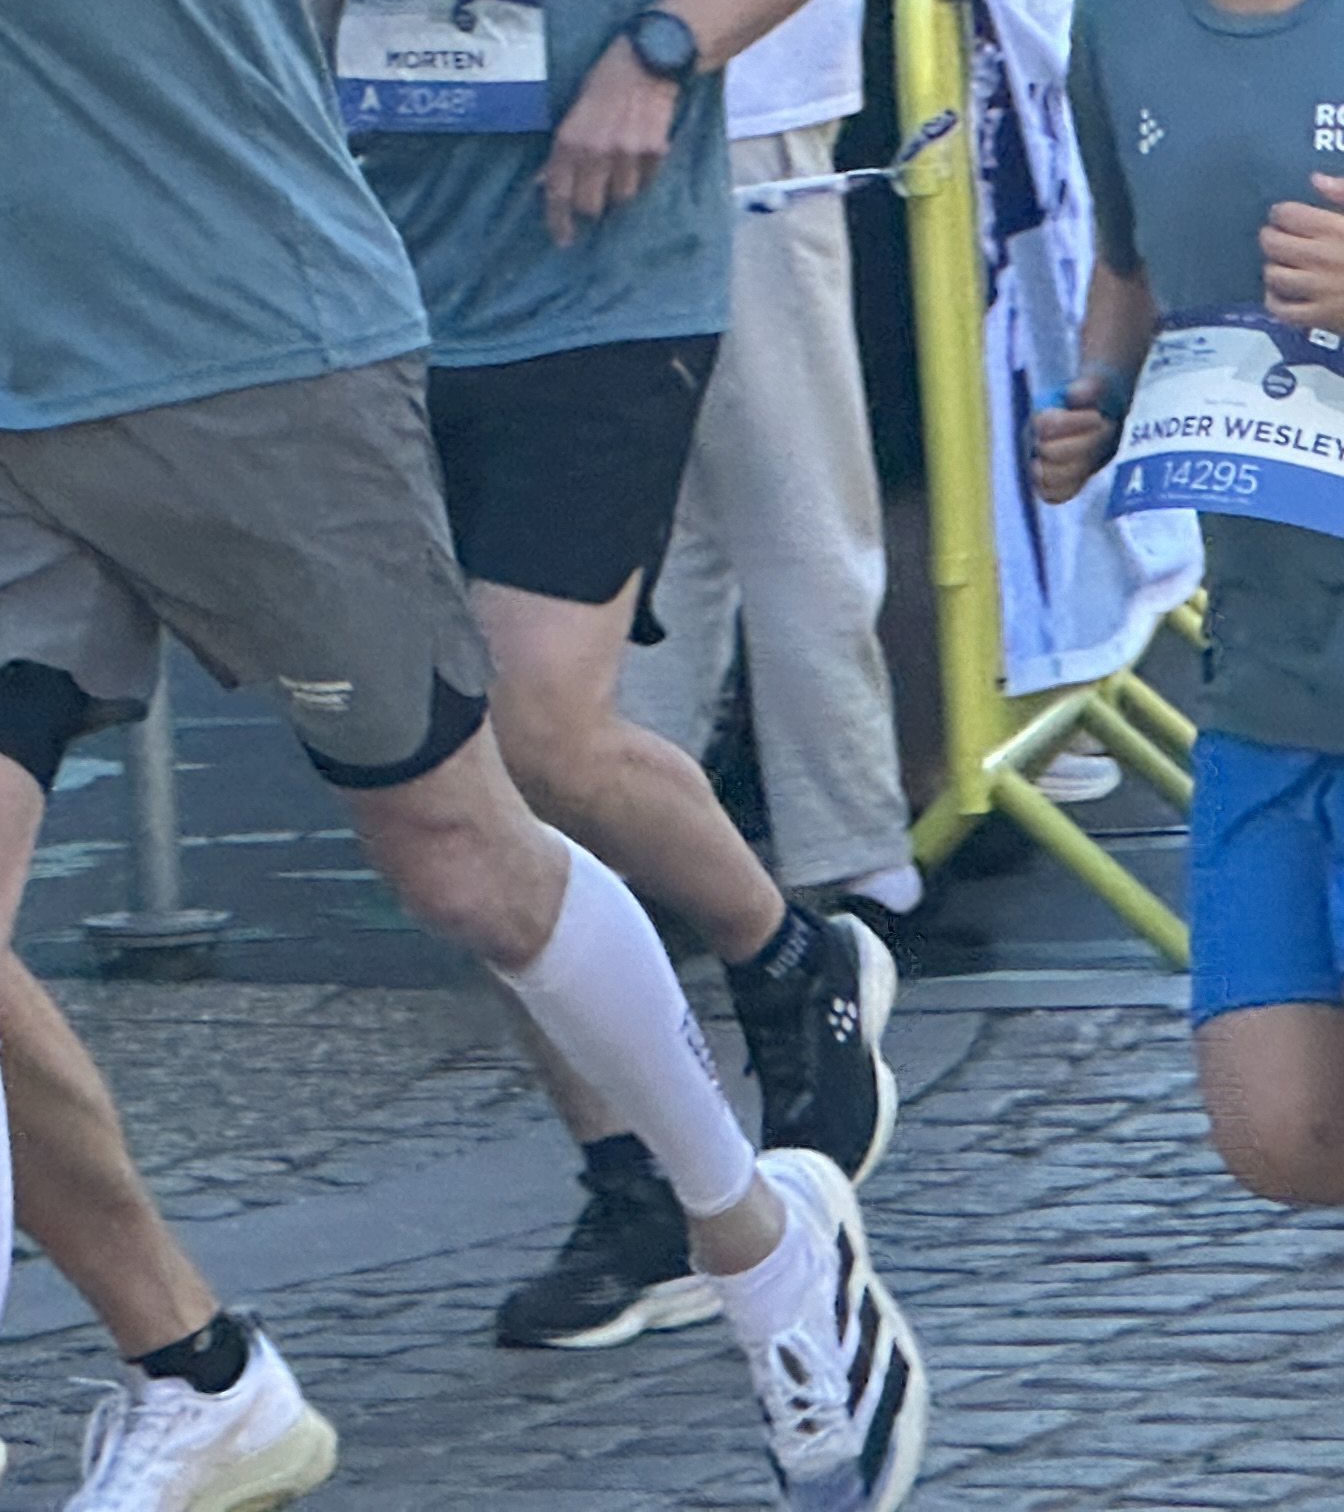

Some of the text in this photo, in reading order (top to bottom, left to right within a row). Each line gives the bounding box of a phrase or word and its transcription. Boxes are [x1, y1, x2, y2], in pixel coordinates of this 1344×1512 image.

[360, 86, 382, 112] A
[1129, 415, 1214, 447] SANDER
[1124, 459, 1263, 496] A 14295
